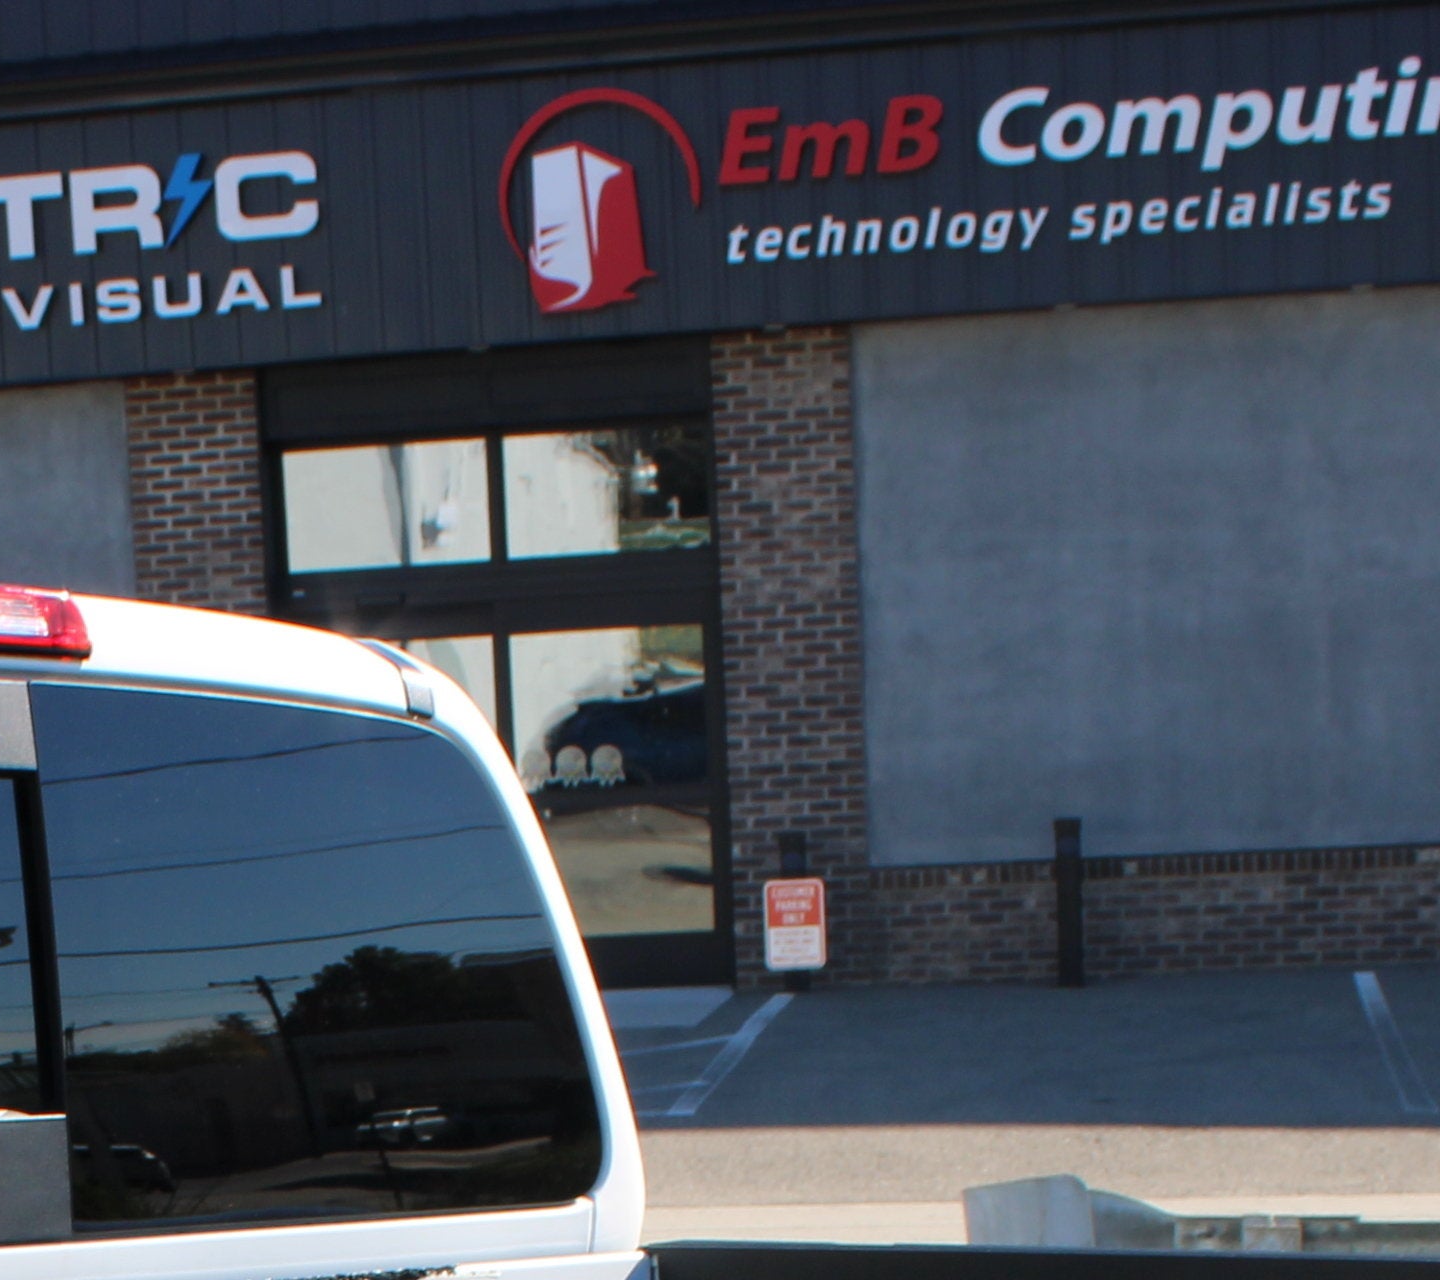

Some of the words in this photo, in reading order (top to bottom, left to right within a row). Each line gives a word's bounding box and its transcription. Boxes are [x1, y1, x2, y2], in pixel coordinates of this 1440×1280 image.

[717, 94, 942, 186] EmB
[727, 204, 1048, 264] technology
[1069, 180, 1392, 245] specialists
[3, 265, 322, 331] VISUAL
